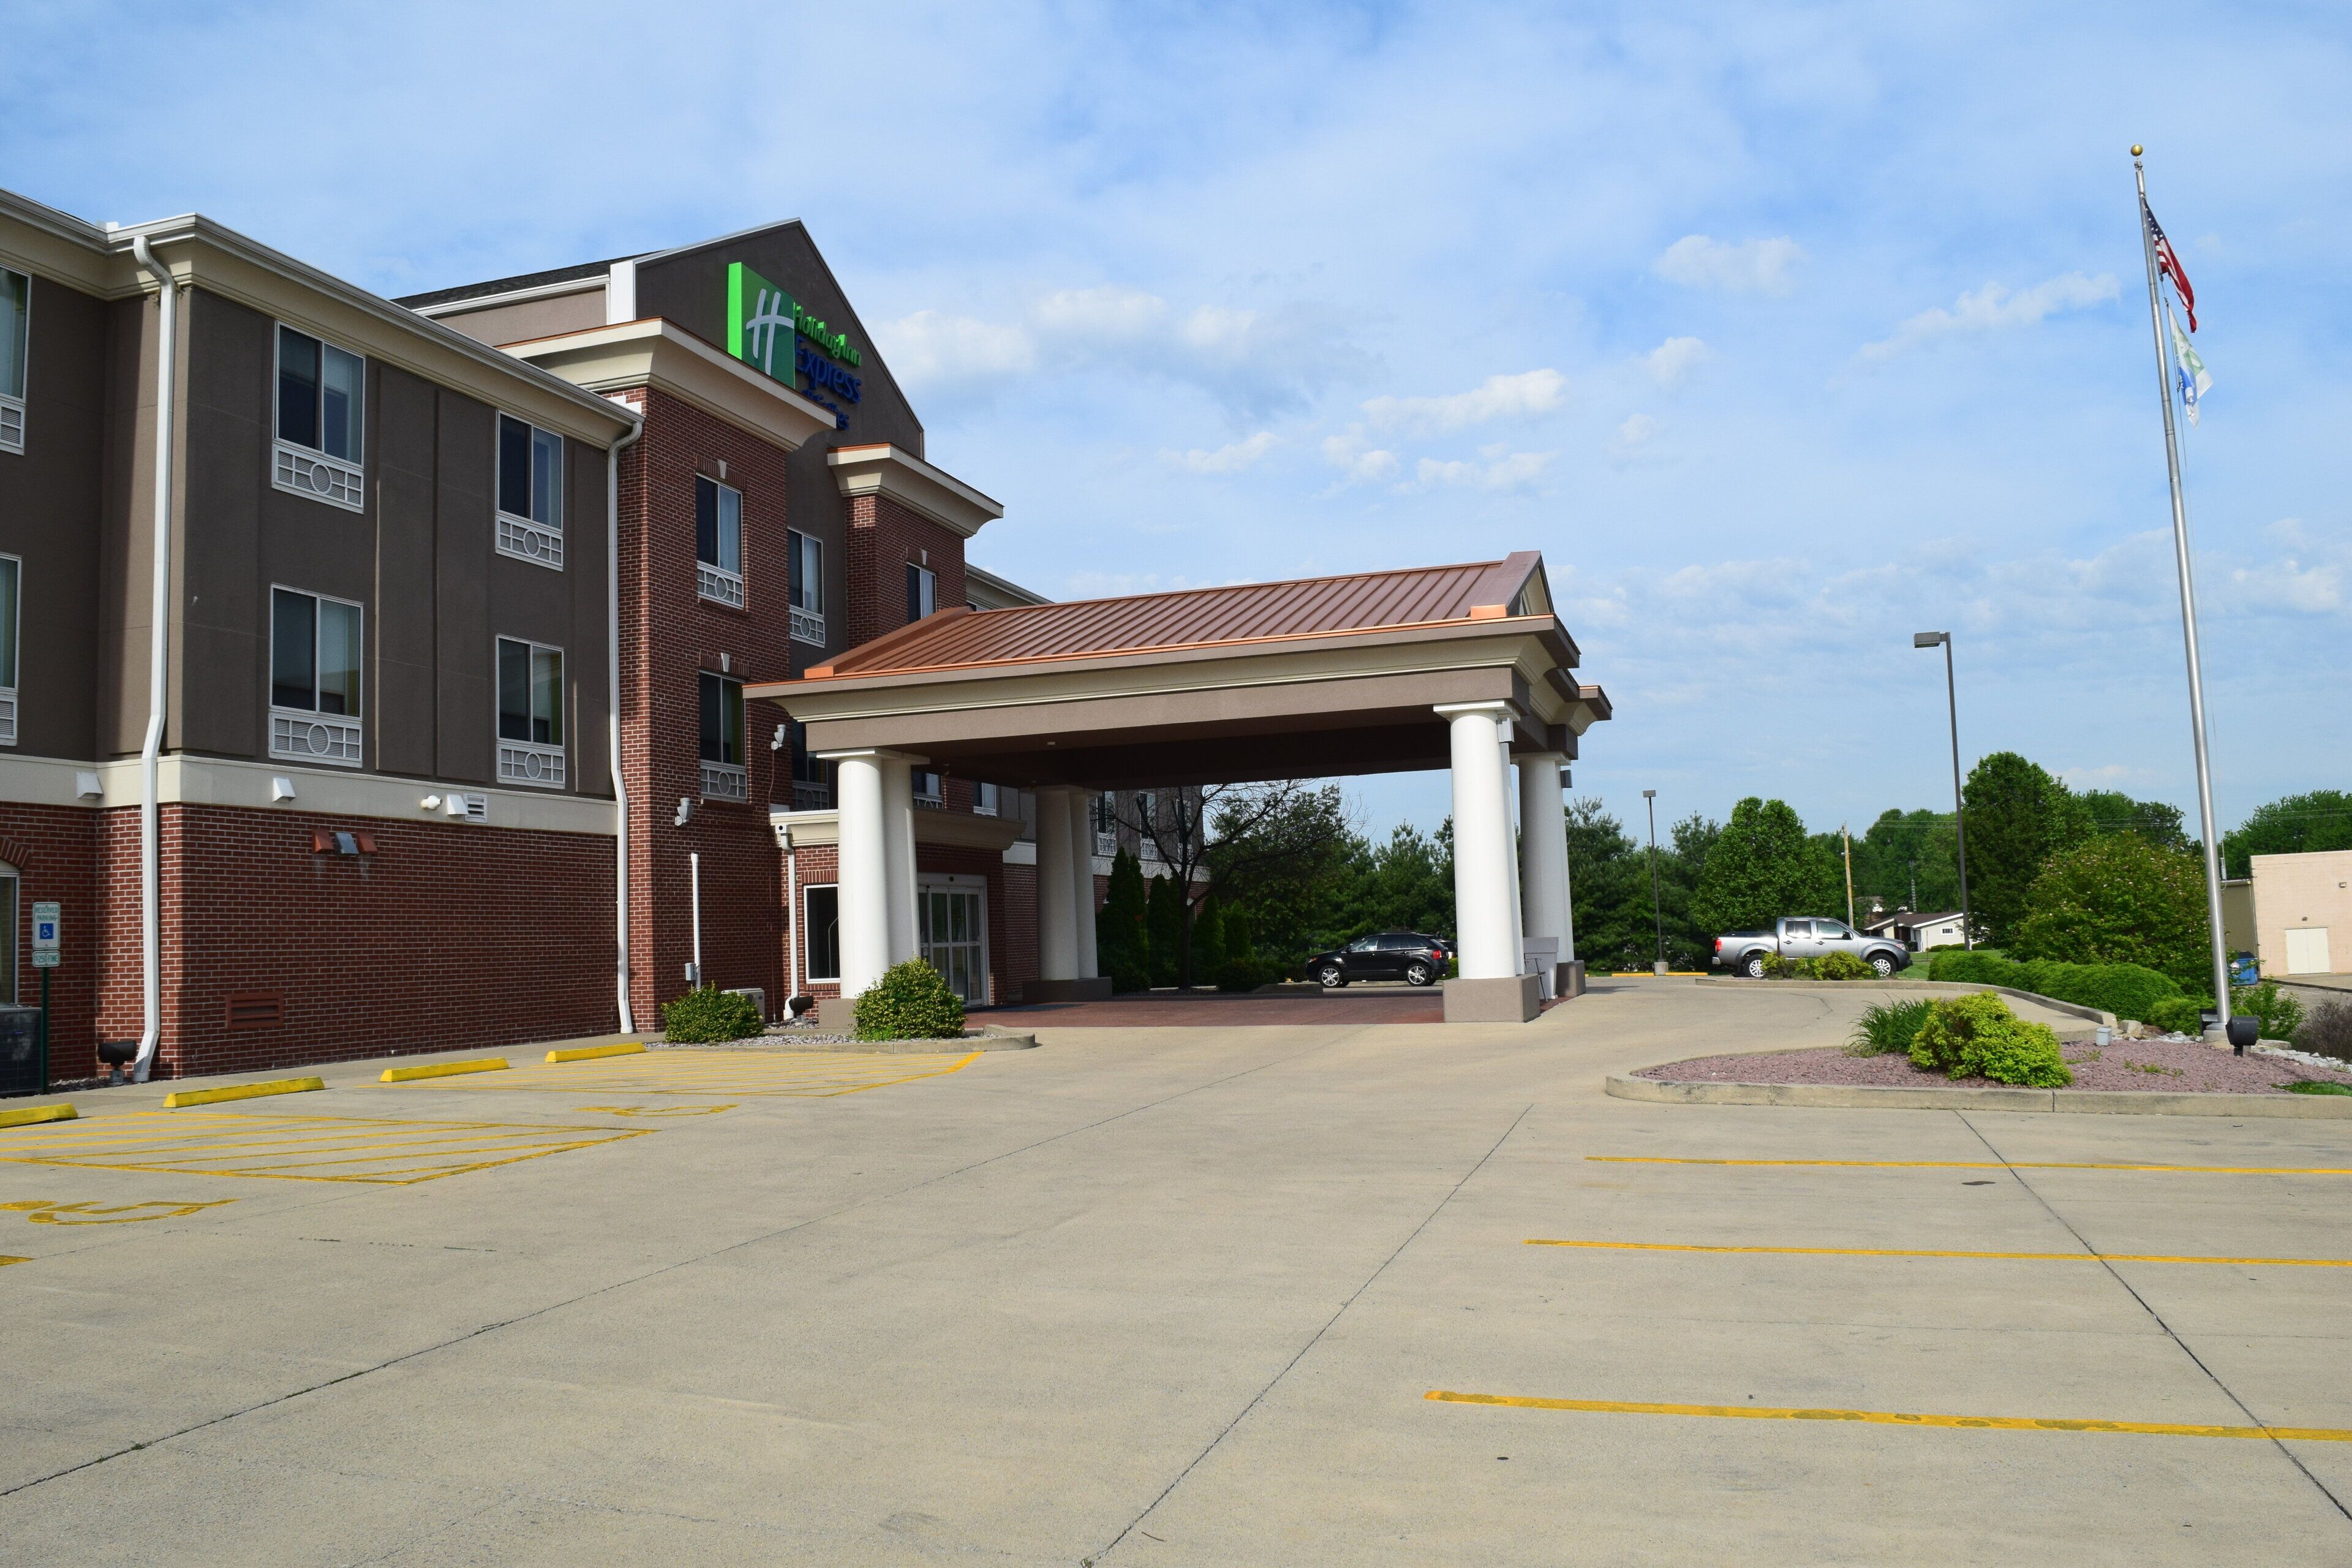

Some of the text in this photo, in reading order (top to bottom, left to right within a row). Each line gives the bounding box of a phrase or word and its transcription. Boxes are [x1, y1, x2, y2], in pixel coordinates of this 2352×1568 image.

[794, 302, 861, 368] Holiday Inn
[794, 334, 862, 403] Express
